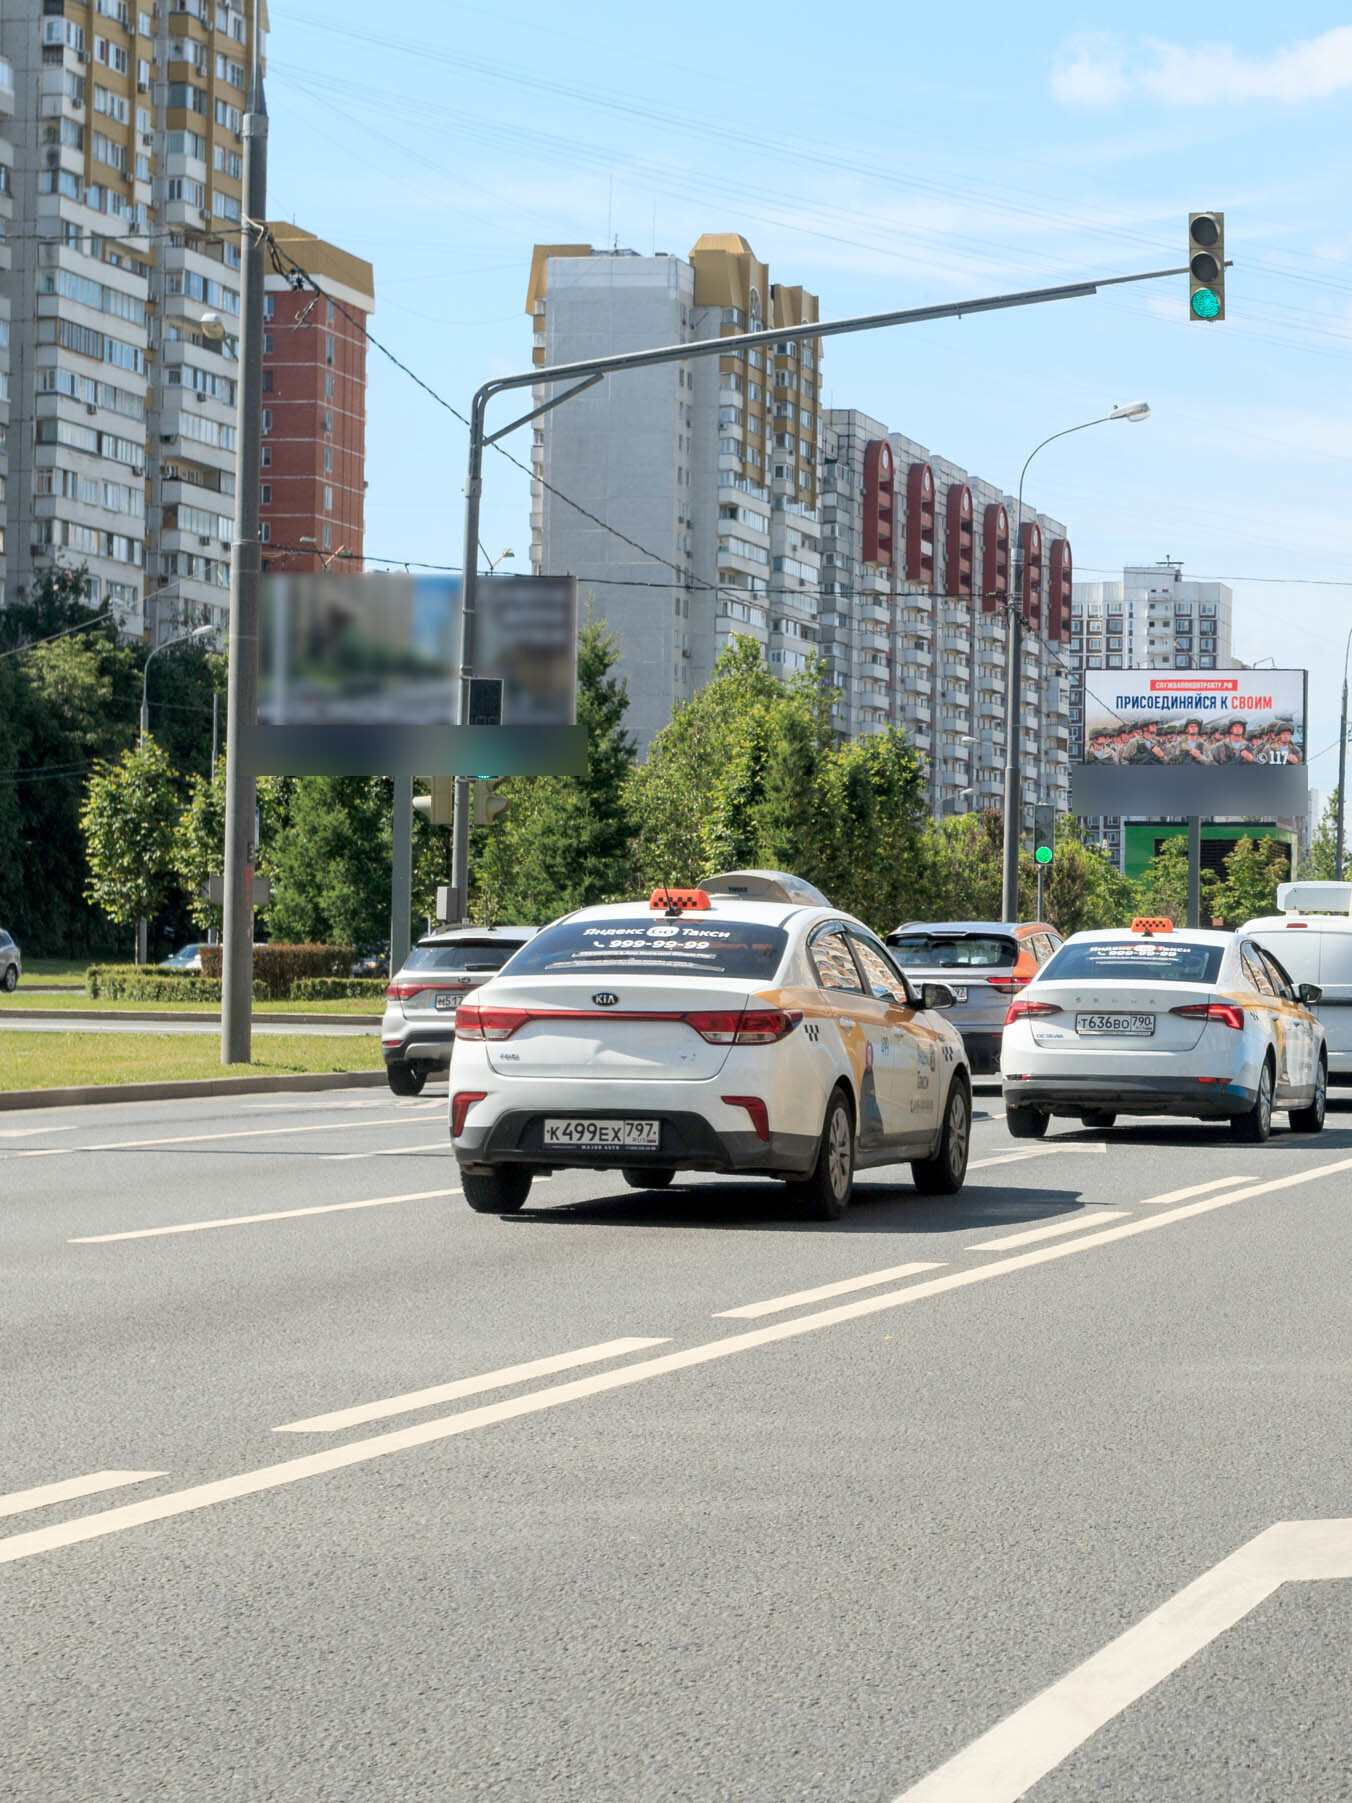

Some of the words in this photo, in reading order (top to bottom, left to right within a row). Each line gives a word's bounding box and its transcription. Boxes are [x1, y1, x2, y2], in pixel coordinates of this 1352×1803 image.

[1116, 693, 1217, 711] ПРИСОЕДИНЯЙСЯ
[1220, 695, 1229, 710] К
[1231, 695, 1273, 710] СВОИМ
[1268, 751, 1289, 765] 117
[583, 928, 646, 937] Яндекс
[682, 928, 731, 938] Такси
[608, 940, 711, 950] 999-99-99
[437, 995, 464, 1008] М517
[595, 994, 616, 1005] KIA
[1081, 1016, 1130, 1030] Т636ВО
[1132, 1016, 1151, 1026] 790
[550, 1122, 622, 1142] К499ЕХ
[626, 1122, 654, 1138] 797
